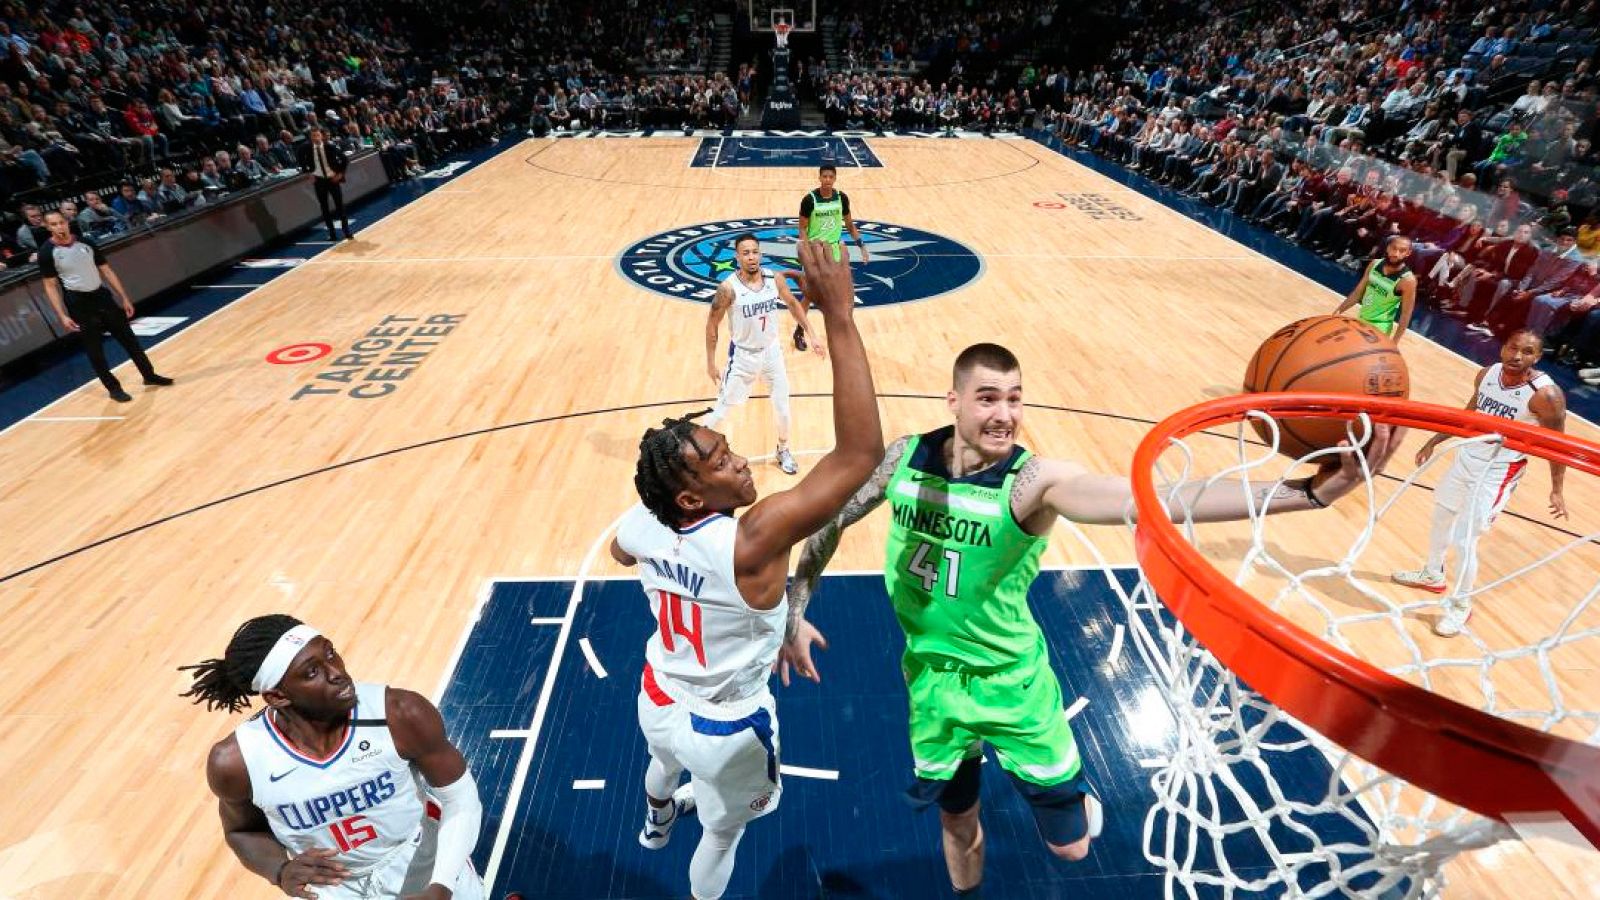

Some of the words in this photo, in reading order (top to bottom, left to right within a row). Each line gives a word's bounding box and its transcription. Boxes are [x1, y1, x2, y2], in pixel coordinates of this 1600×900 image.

[759, 316, 767, 333] 7
[290, 314, 418, 401] TARGET
[348, 313, 467, 399] CENTER
[893, 503, 992, 547] MINNESOTA
[908, 540, 962, 599] 41
[656, 588, 708, 670] 14
[277, 769, 396, 831] CLIPPERS
[328, 814, 379, 854] 15
